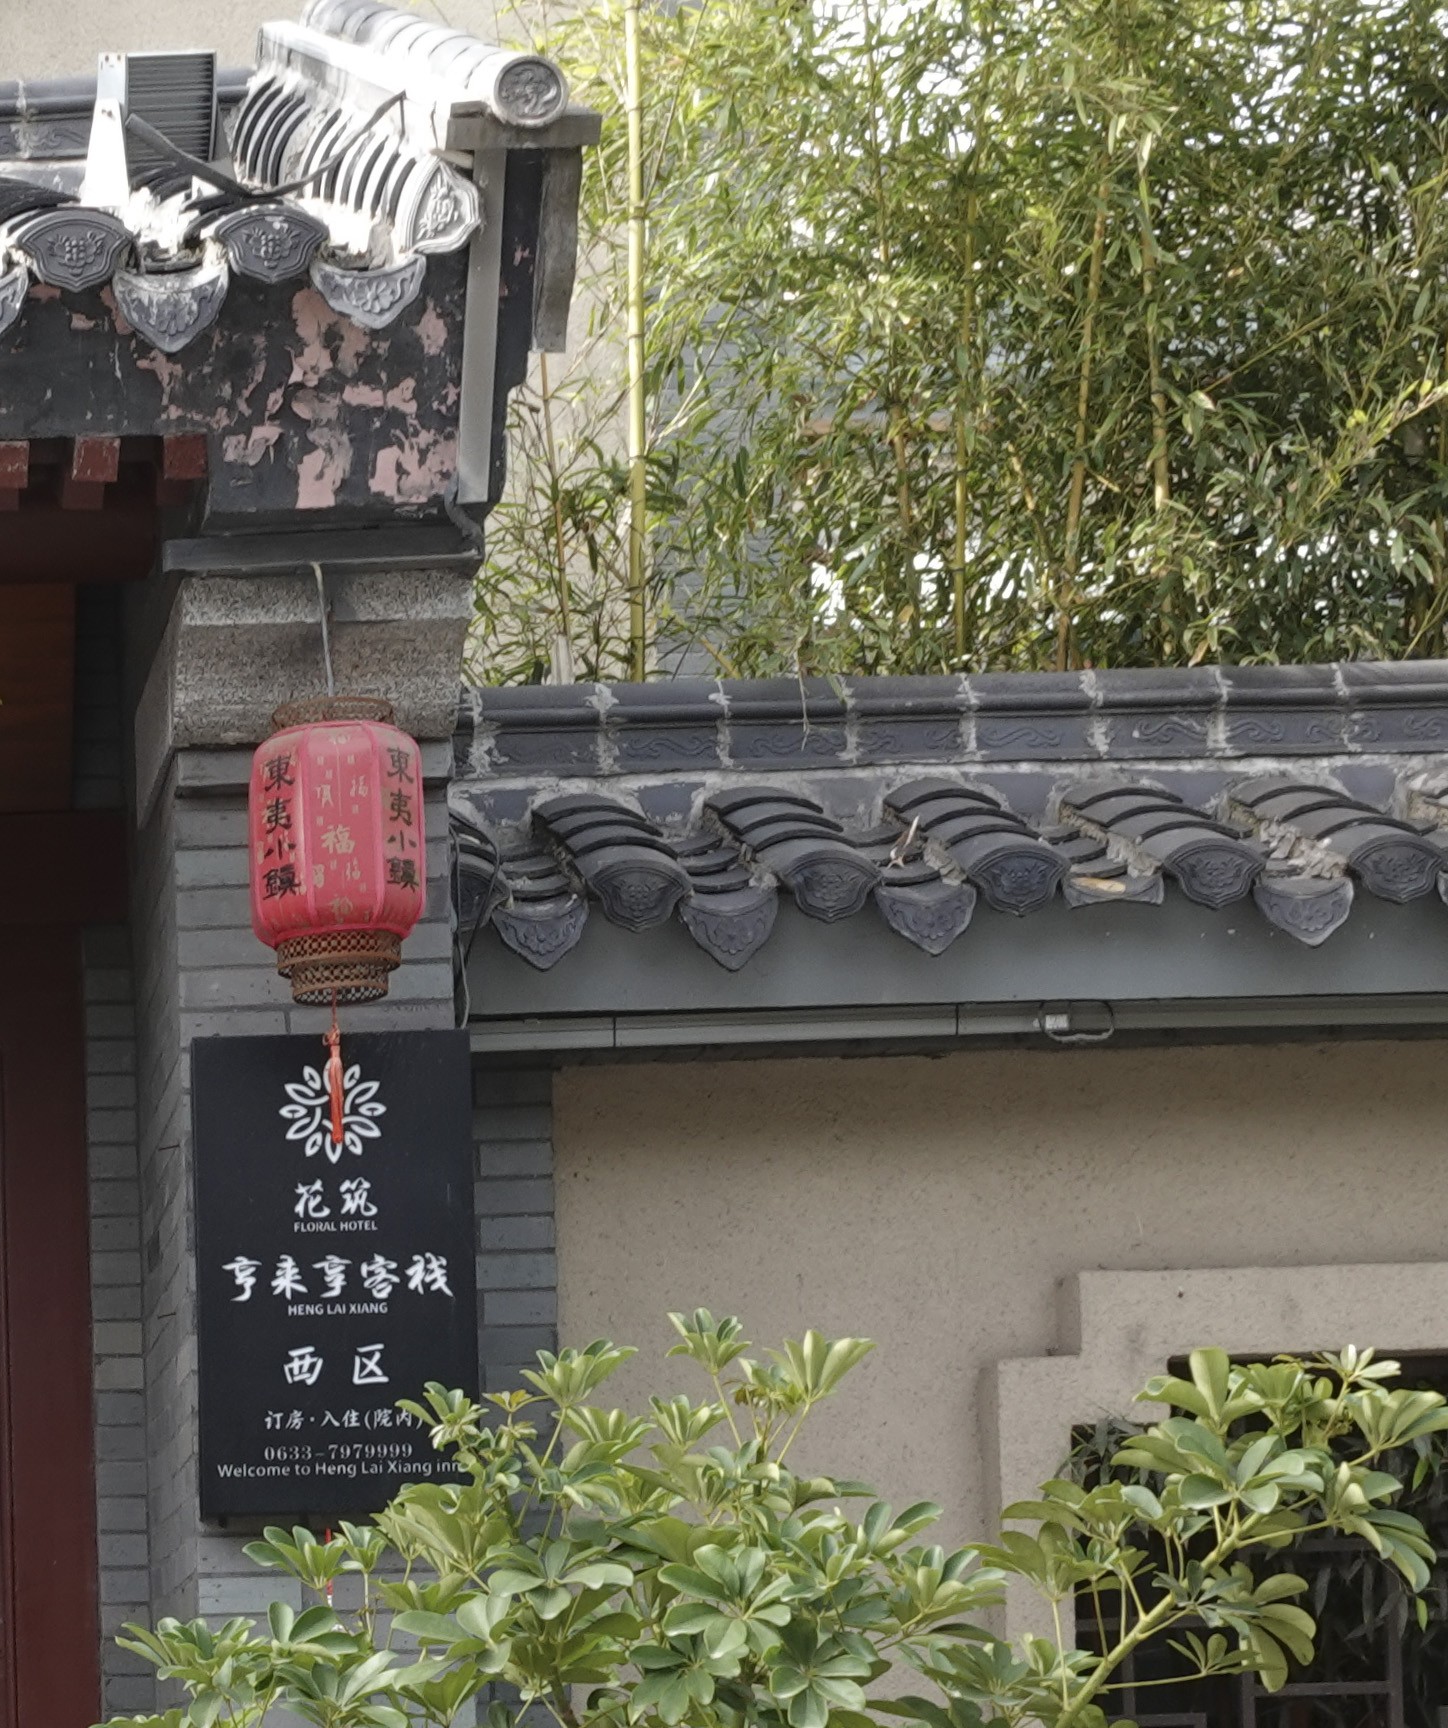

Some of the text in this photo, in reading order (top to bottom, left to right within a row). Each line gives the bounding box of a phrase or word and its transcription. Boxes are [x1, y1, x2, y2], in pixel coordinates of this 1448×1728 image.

[294, 1176, 378, 1218] 花筑
[294, 1219, 378, 1233] FLORAL HOTEL
[288, 1302, 388, 1317] HENG LAI XIANG
[283, 1343, 390, 1386] 西区
[264, 1443, 413, 1462] 0633-7979999
[217, 1463, 291, 1478] Welcome
[294, 1462, 311, 1476] to
[315, 1461, 357, 1478] Heng
[361, 1460, 384, 1475] Lai
[387, 1459, 432, 1477] Xiang
